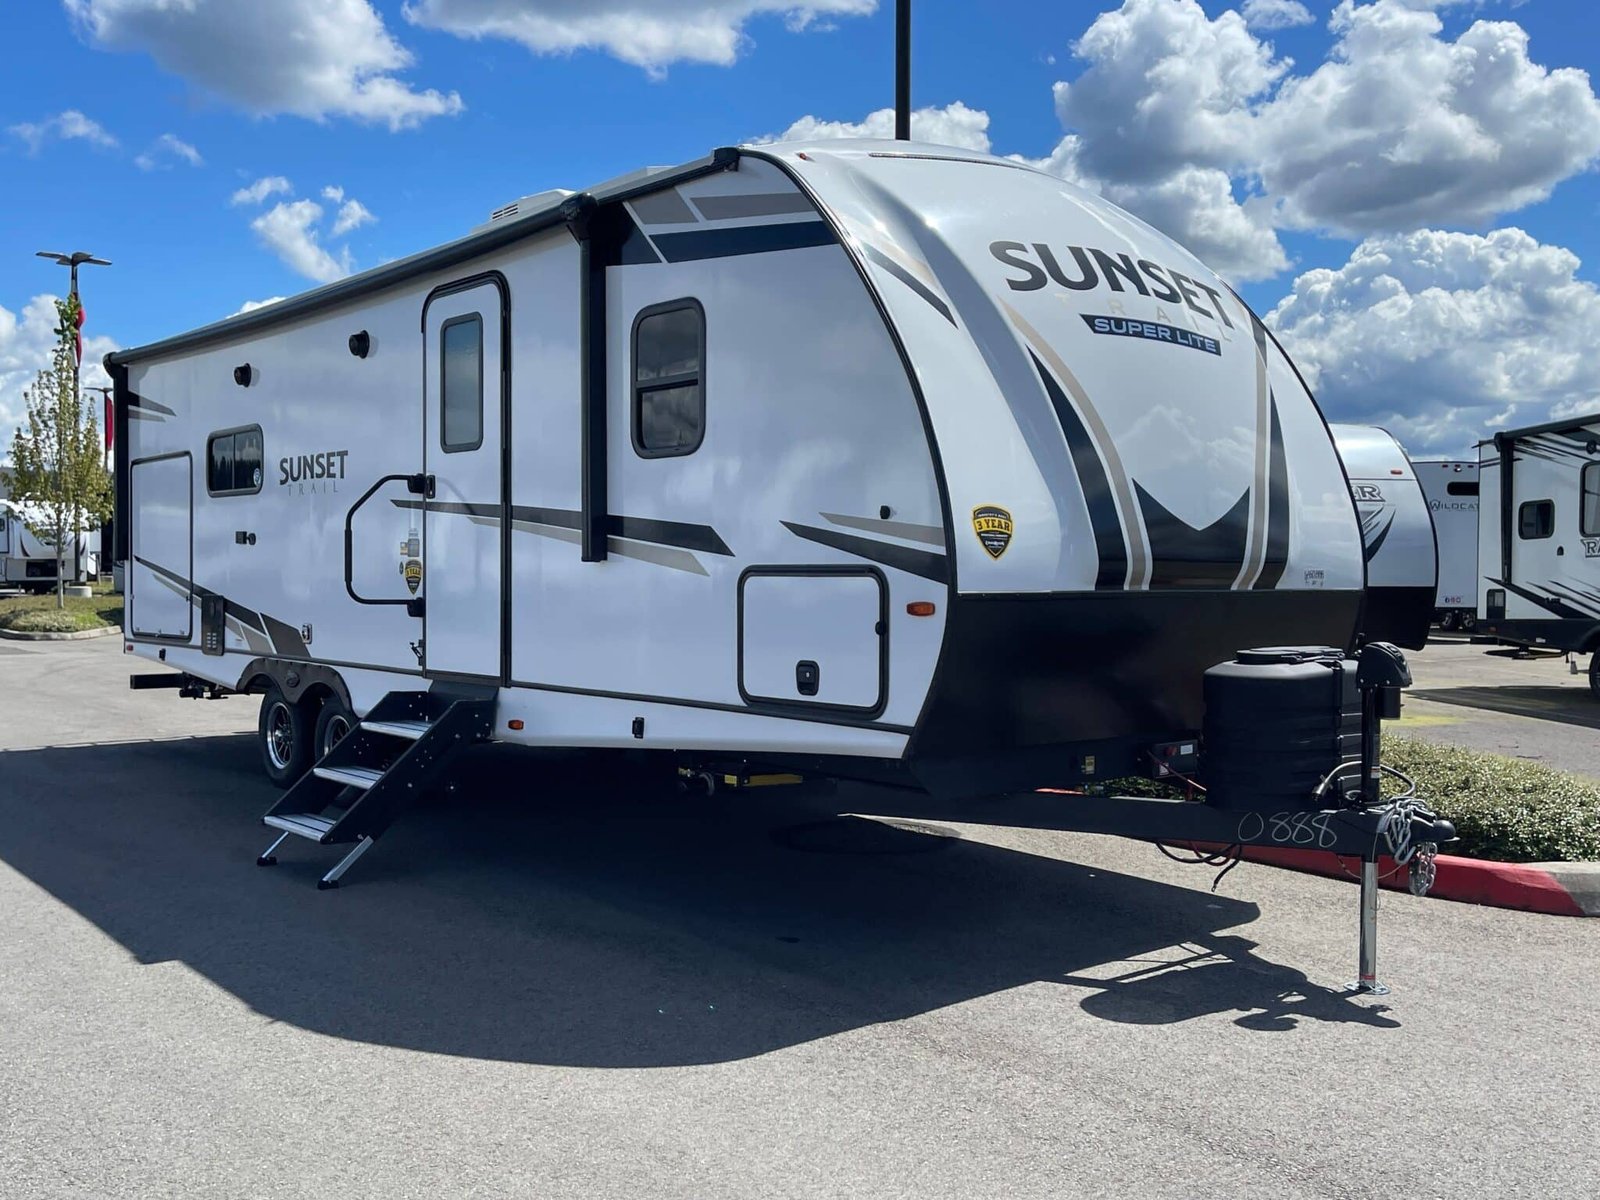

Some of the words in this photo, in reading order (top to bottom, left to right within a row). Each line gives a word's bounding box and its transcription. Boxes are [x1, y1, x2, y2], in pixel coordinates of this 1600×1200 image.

[988, 240, 1234, 329] SUNSET
[1094, 318, 1172, 340] SUPER
[1177, 330, 1217, 352] LITE
[279, 450, 348, 485] SUNSET
[287, 480, 339, 496] TRAIL
[977, 520, 983, 530] 3
[984, 518, 1010, 532] YEAR
[1237, 811, 1337, 848] 0888
